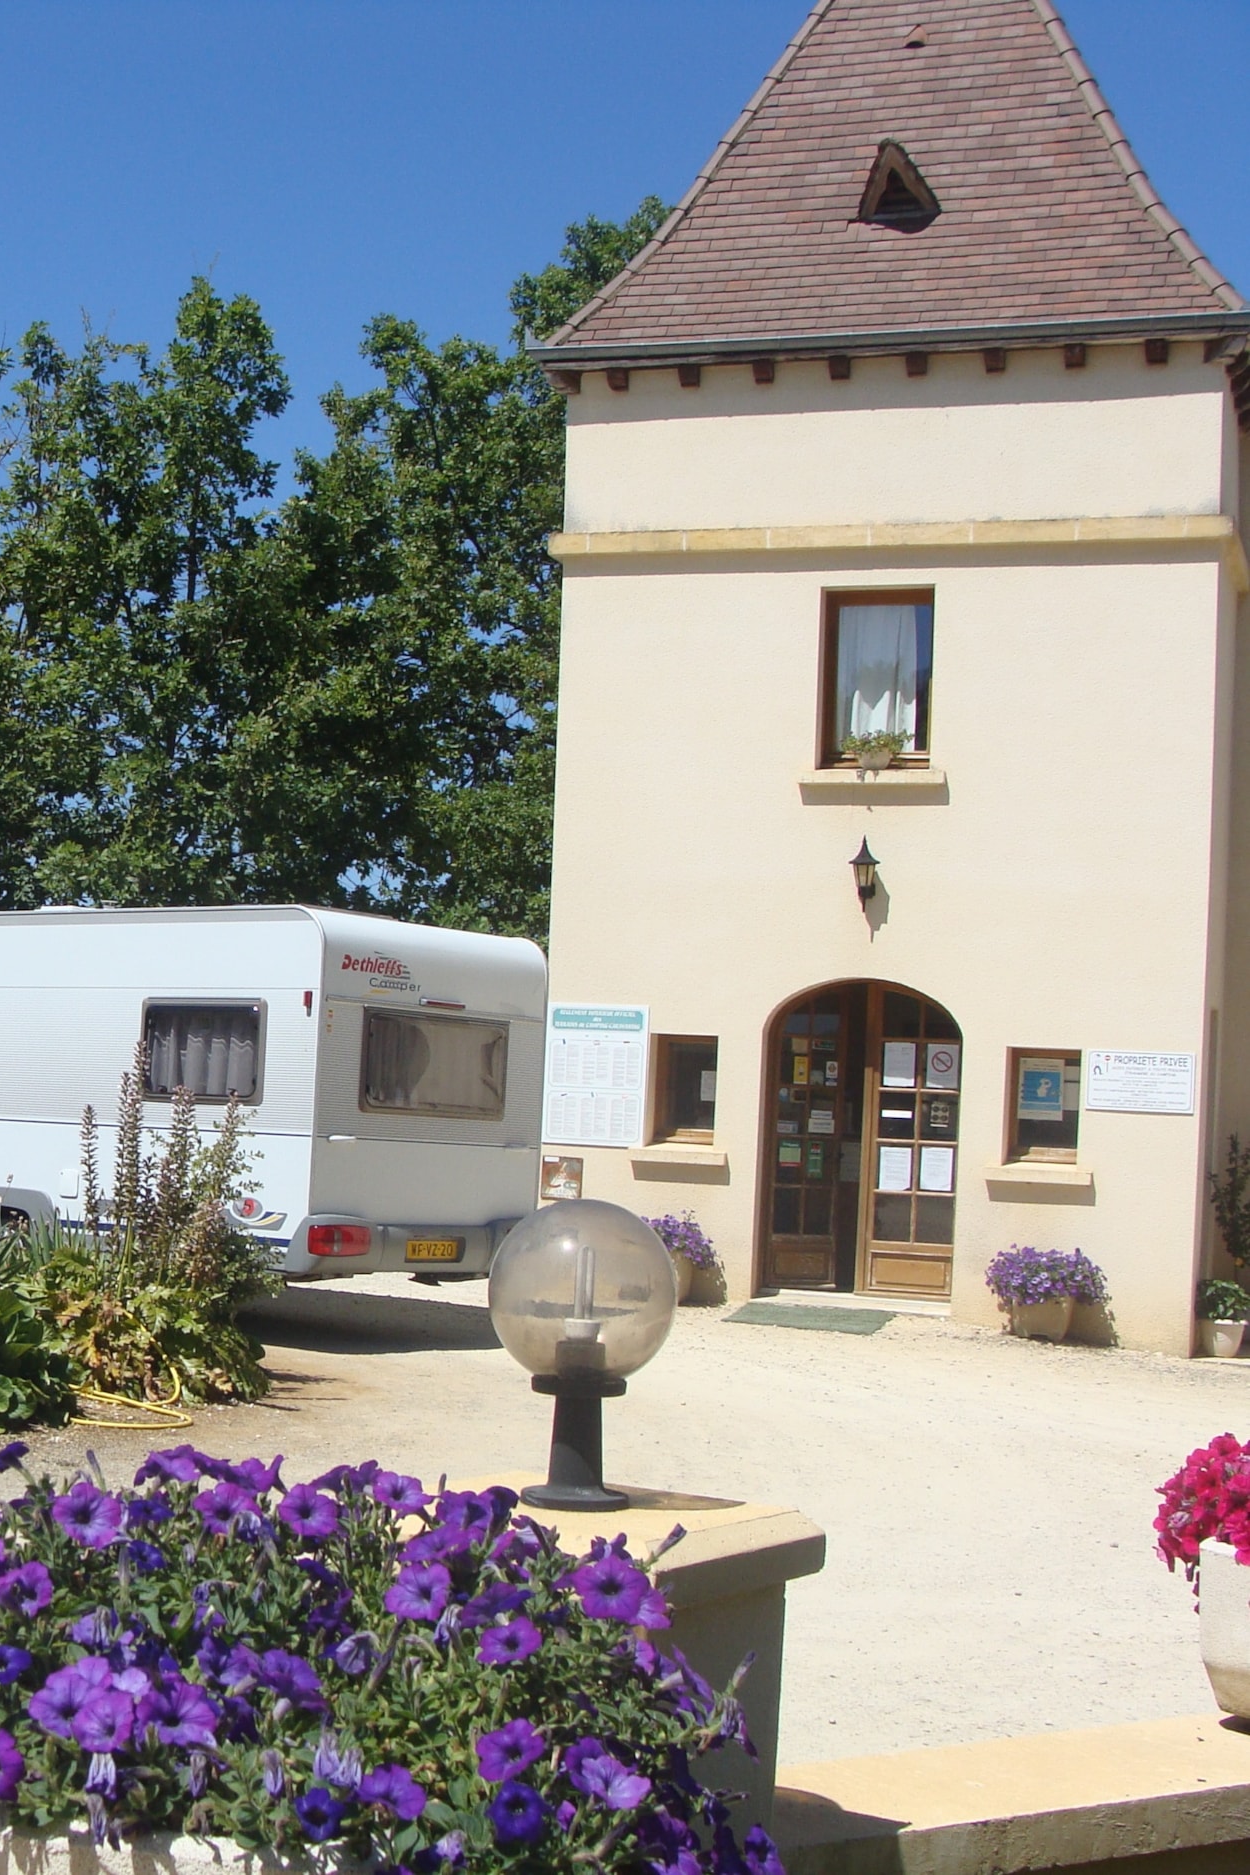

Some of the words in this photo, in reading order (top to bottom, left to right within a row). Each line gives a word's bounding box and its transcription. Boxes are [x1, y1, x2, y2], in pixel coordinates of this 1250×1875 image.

[341, 954, 403, 976] Dethleffs
[369, 977, 421, 992] Camper
[1114, 1055, 1157, 1066] PROPRIETE
[1160, 1057, 1188, 1067] PRIVEE
[411, 1243, 453, 1257] WF-VZ-20
